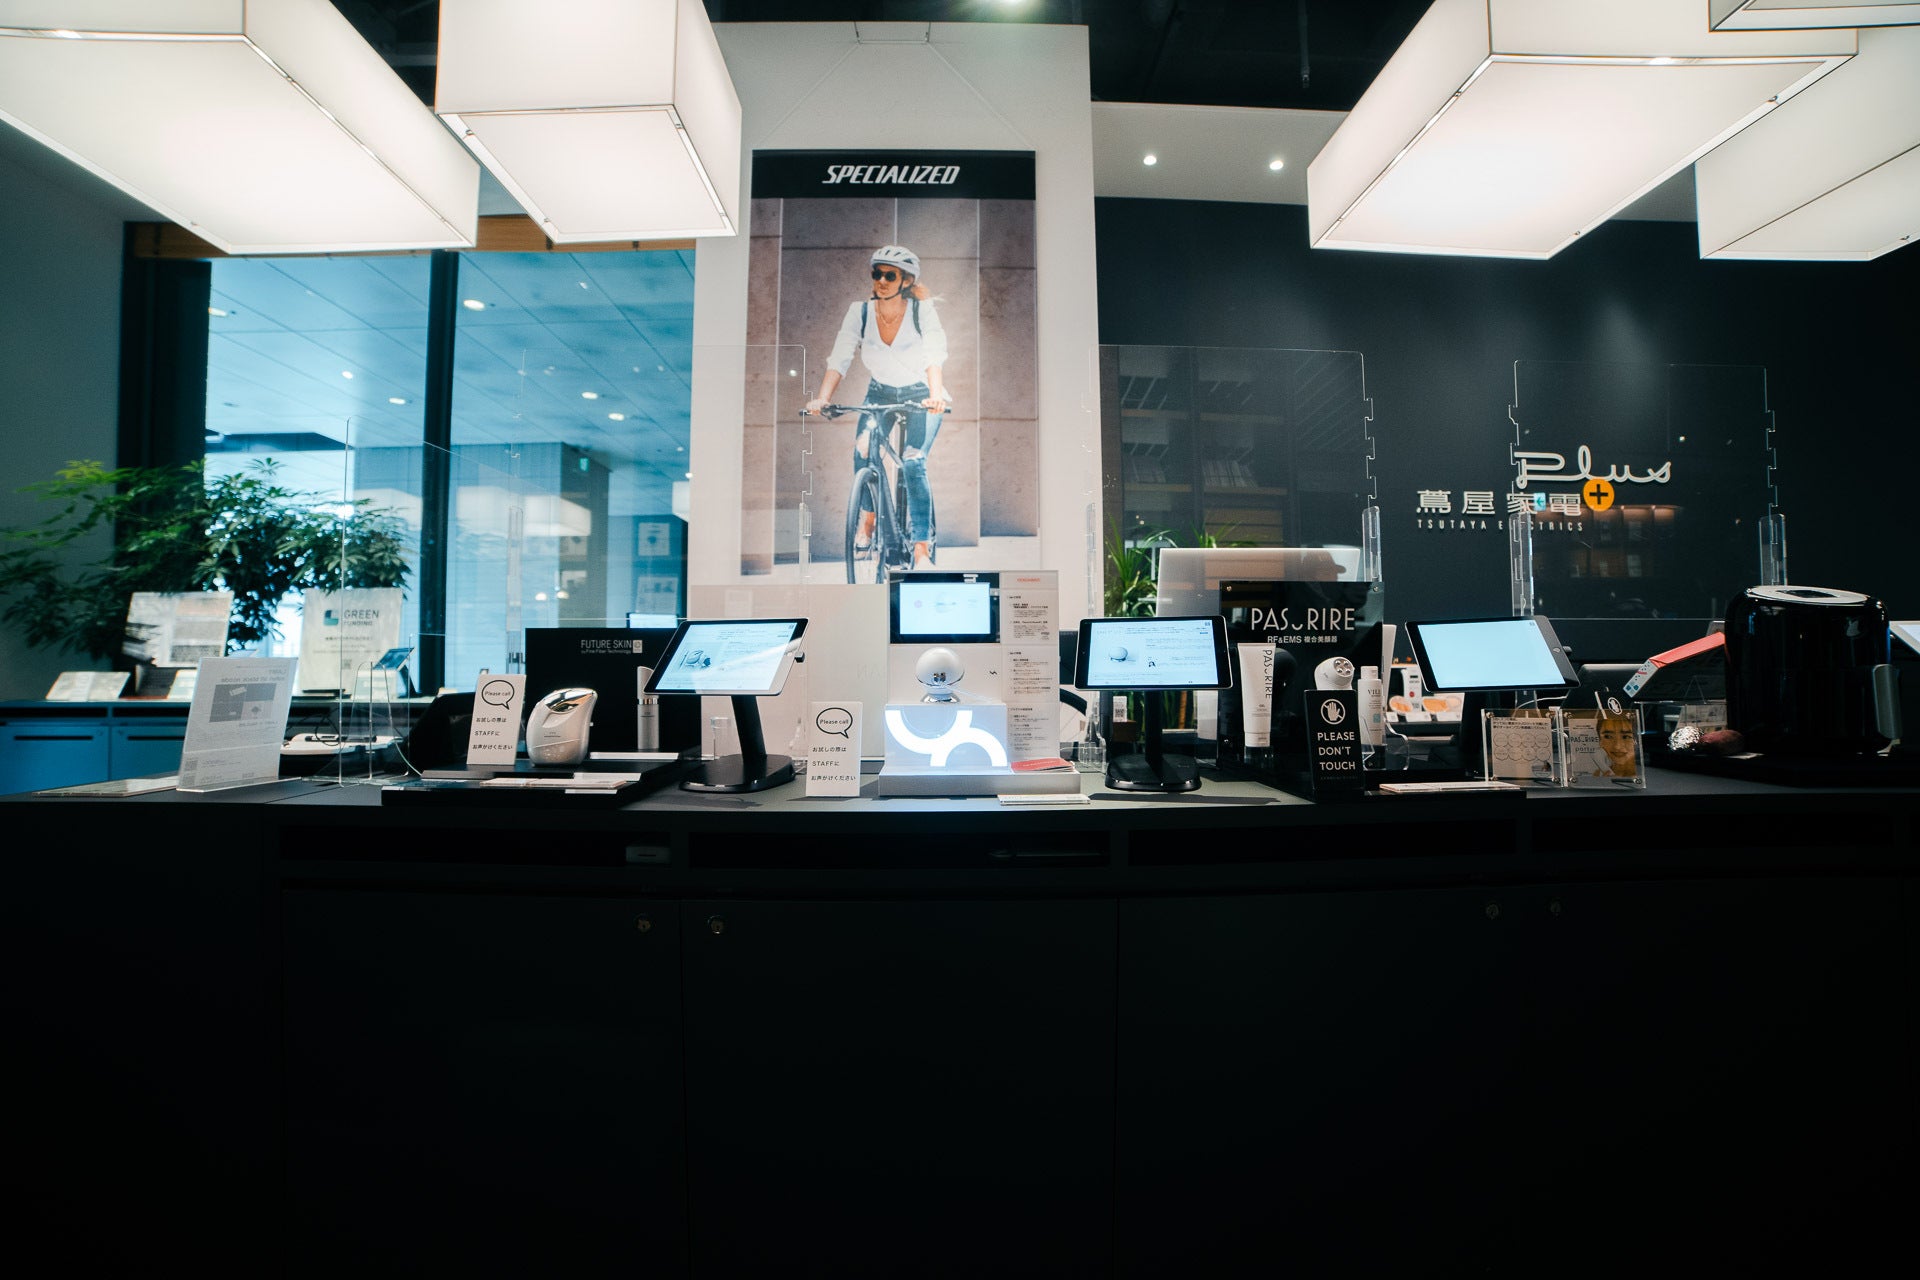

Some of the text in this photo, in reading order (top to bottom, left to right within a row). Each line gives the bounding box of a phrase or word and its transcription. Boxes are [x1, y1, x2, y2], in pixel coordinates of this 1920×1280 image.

[822, 164, 961, 185] SPECIALIZED
[1513, 444, 1673, 489] Plus
[1417, 519, 1584, 532] TSUTAYA ECTRICS
[343, 609, 380, 620] GREEN
[580, 639, 611, 649] FUTURE
[613, 639, 633, 649] SKIN
[1267, 635, 1302, 645] RF&EMS
[1317, 731, 1356, 741] PLEASE
[1318, 746, 1352, 756] DON'T
[1319, 761, 1357, 771] TOUCH
